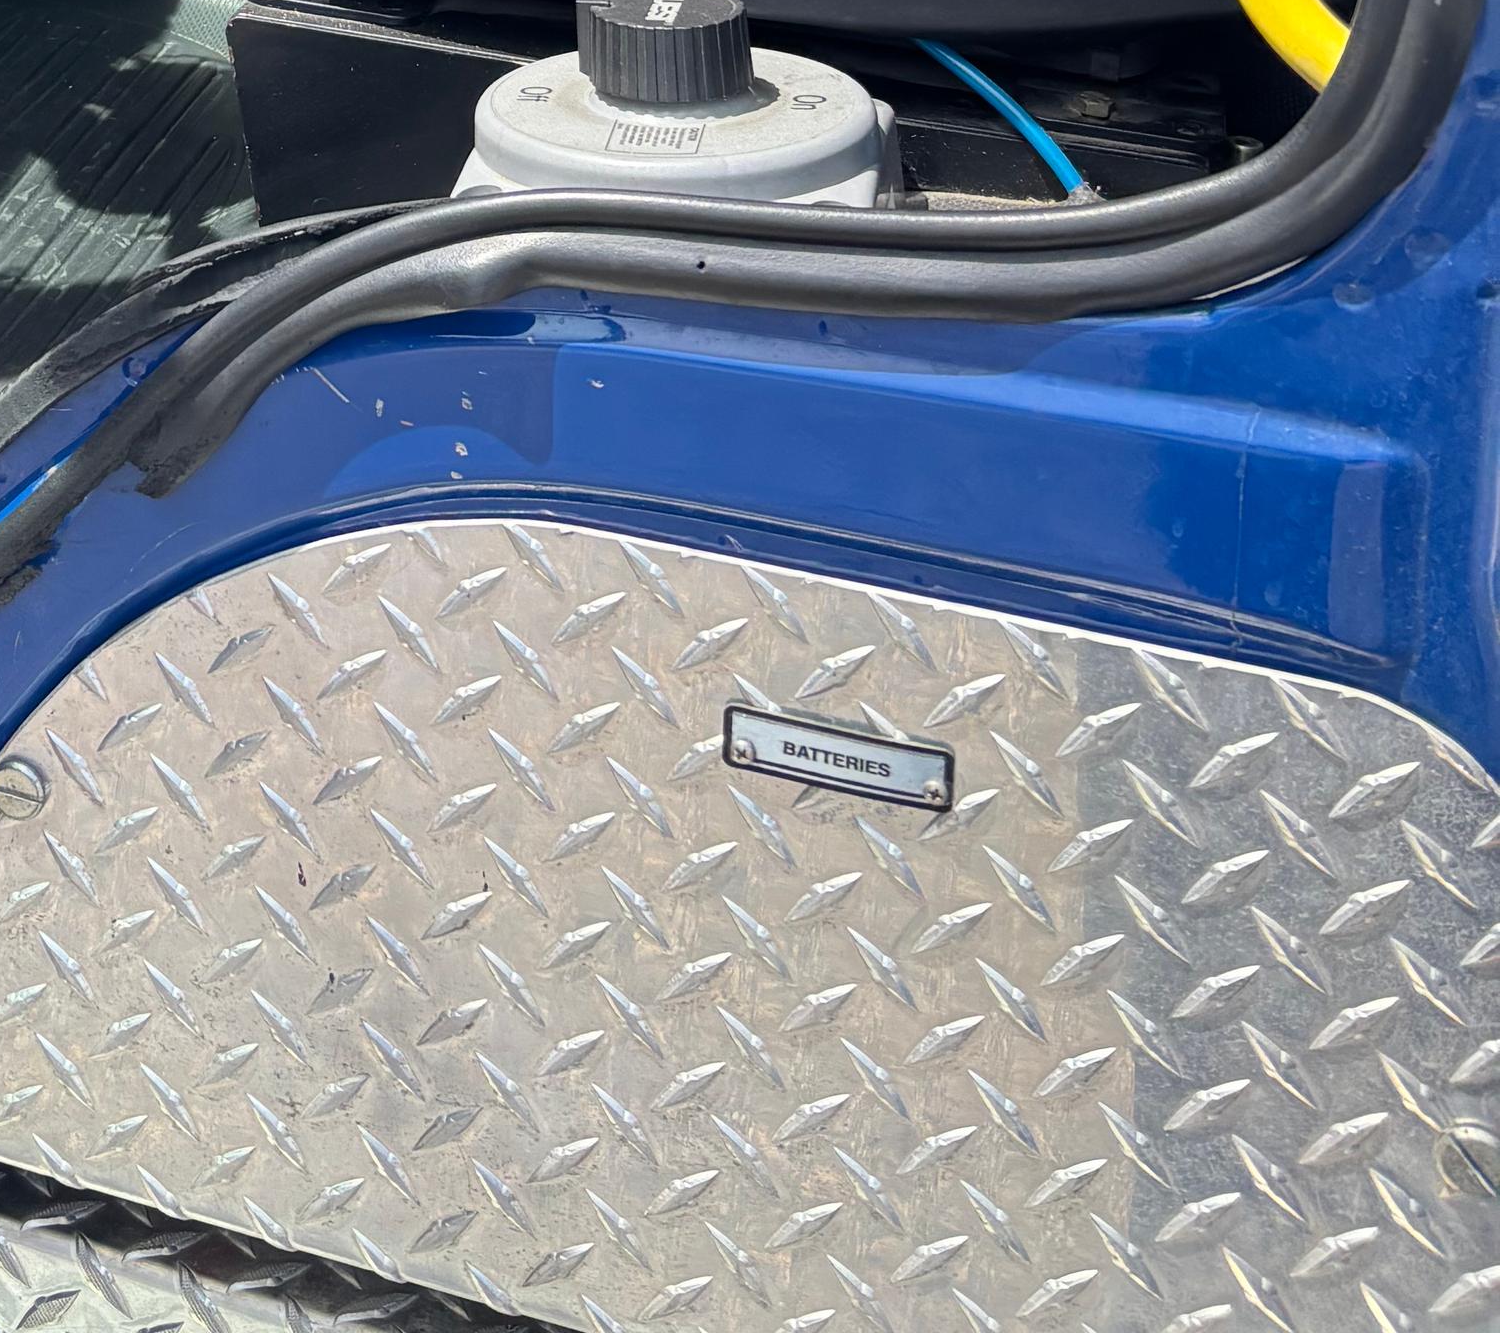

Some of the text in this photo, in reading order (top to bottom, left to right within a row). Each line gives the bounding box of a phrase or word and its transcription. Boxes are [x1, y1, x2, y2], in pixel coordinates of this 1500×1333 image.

[516, 85, 551, 103] Off
[790, 94, 827, 111] On
[782, 740, 892, 778] BATTERIES
